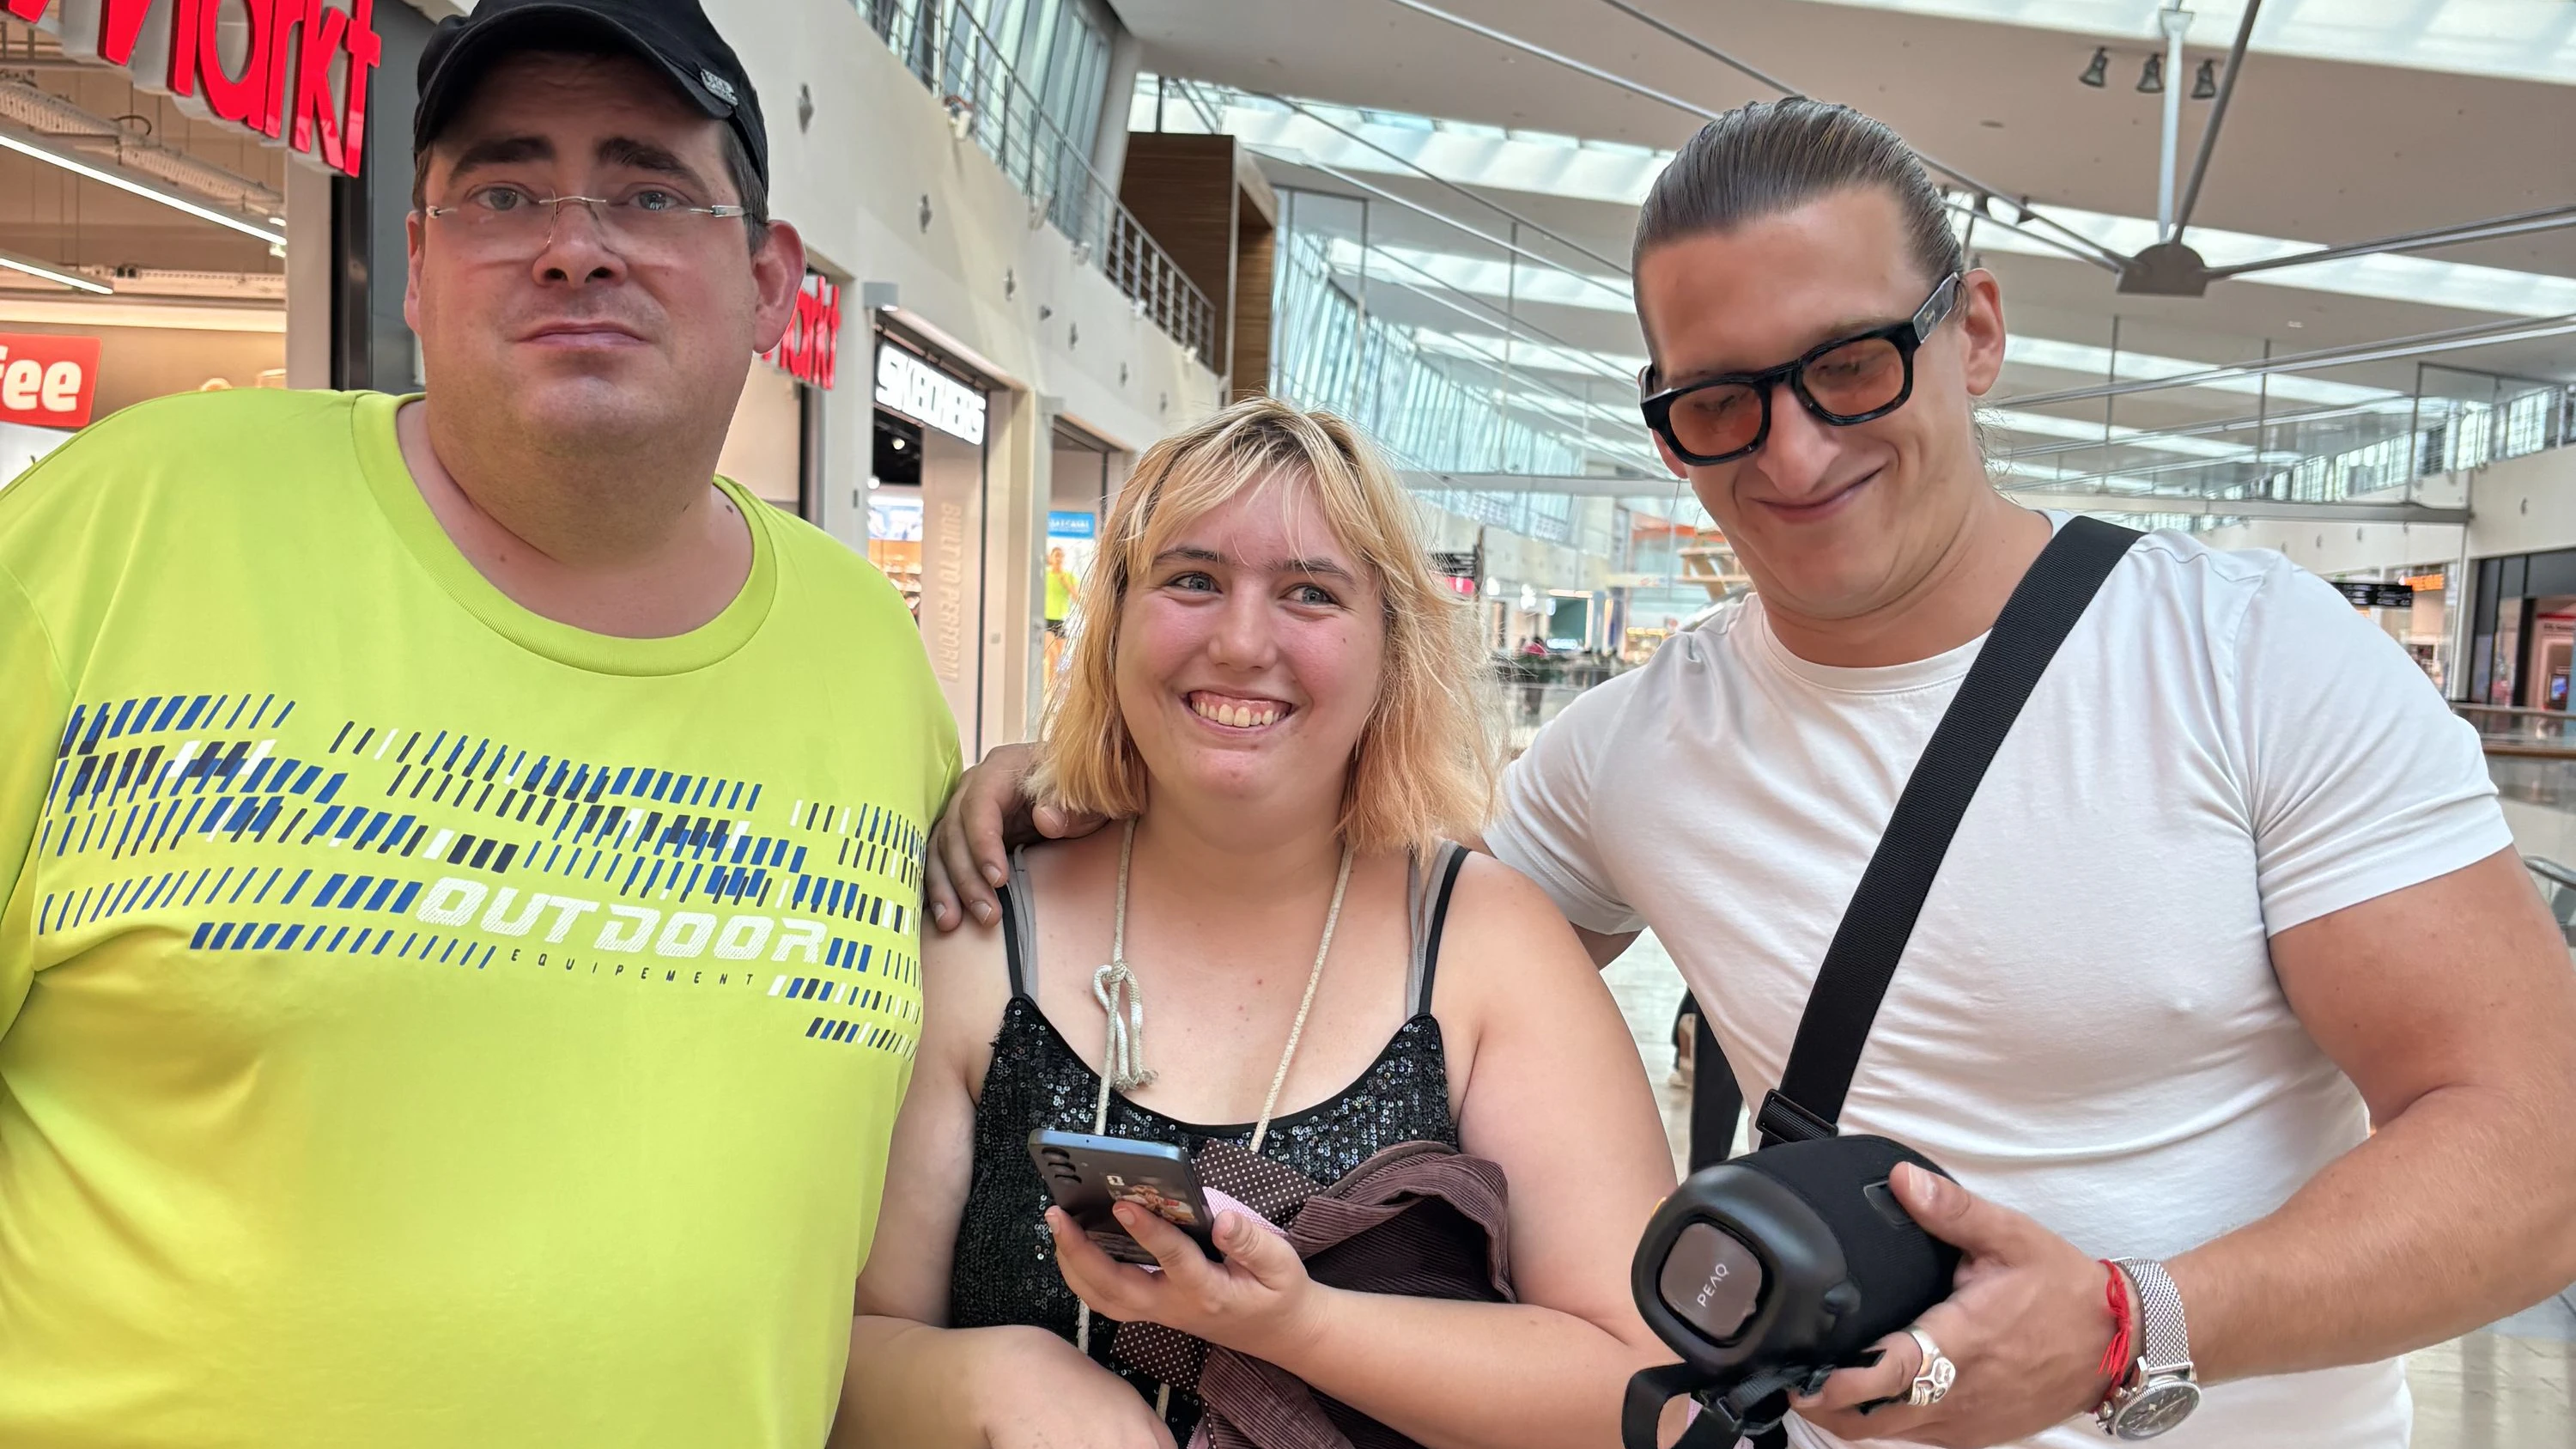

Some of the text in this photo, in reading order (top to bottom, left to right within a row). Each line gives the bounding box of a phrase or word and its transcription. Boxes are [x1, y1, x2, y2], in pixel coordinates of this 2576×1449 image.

[762, 275, 841, 391] arkt
[0, 345, 82, 412] ee
[940, 502, 963, 558] BUILT
[939, 561, 962, 586] TO
[416, 876, 828, 963] OUTDOOR
[510, 948, 755, 985] EQUIPEMENT
[1697, 1263, 1729, 1307] PEAQ
